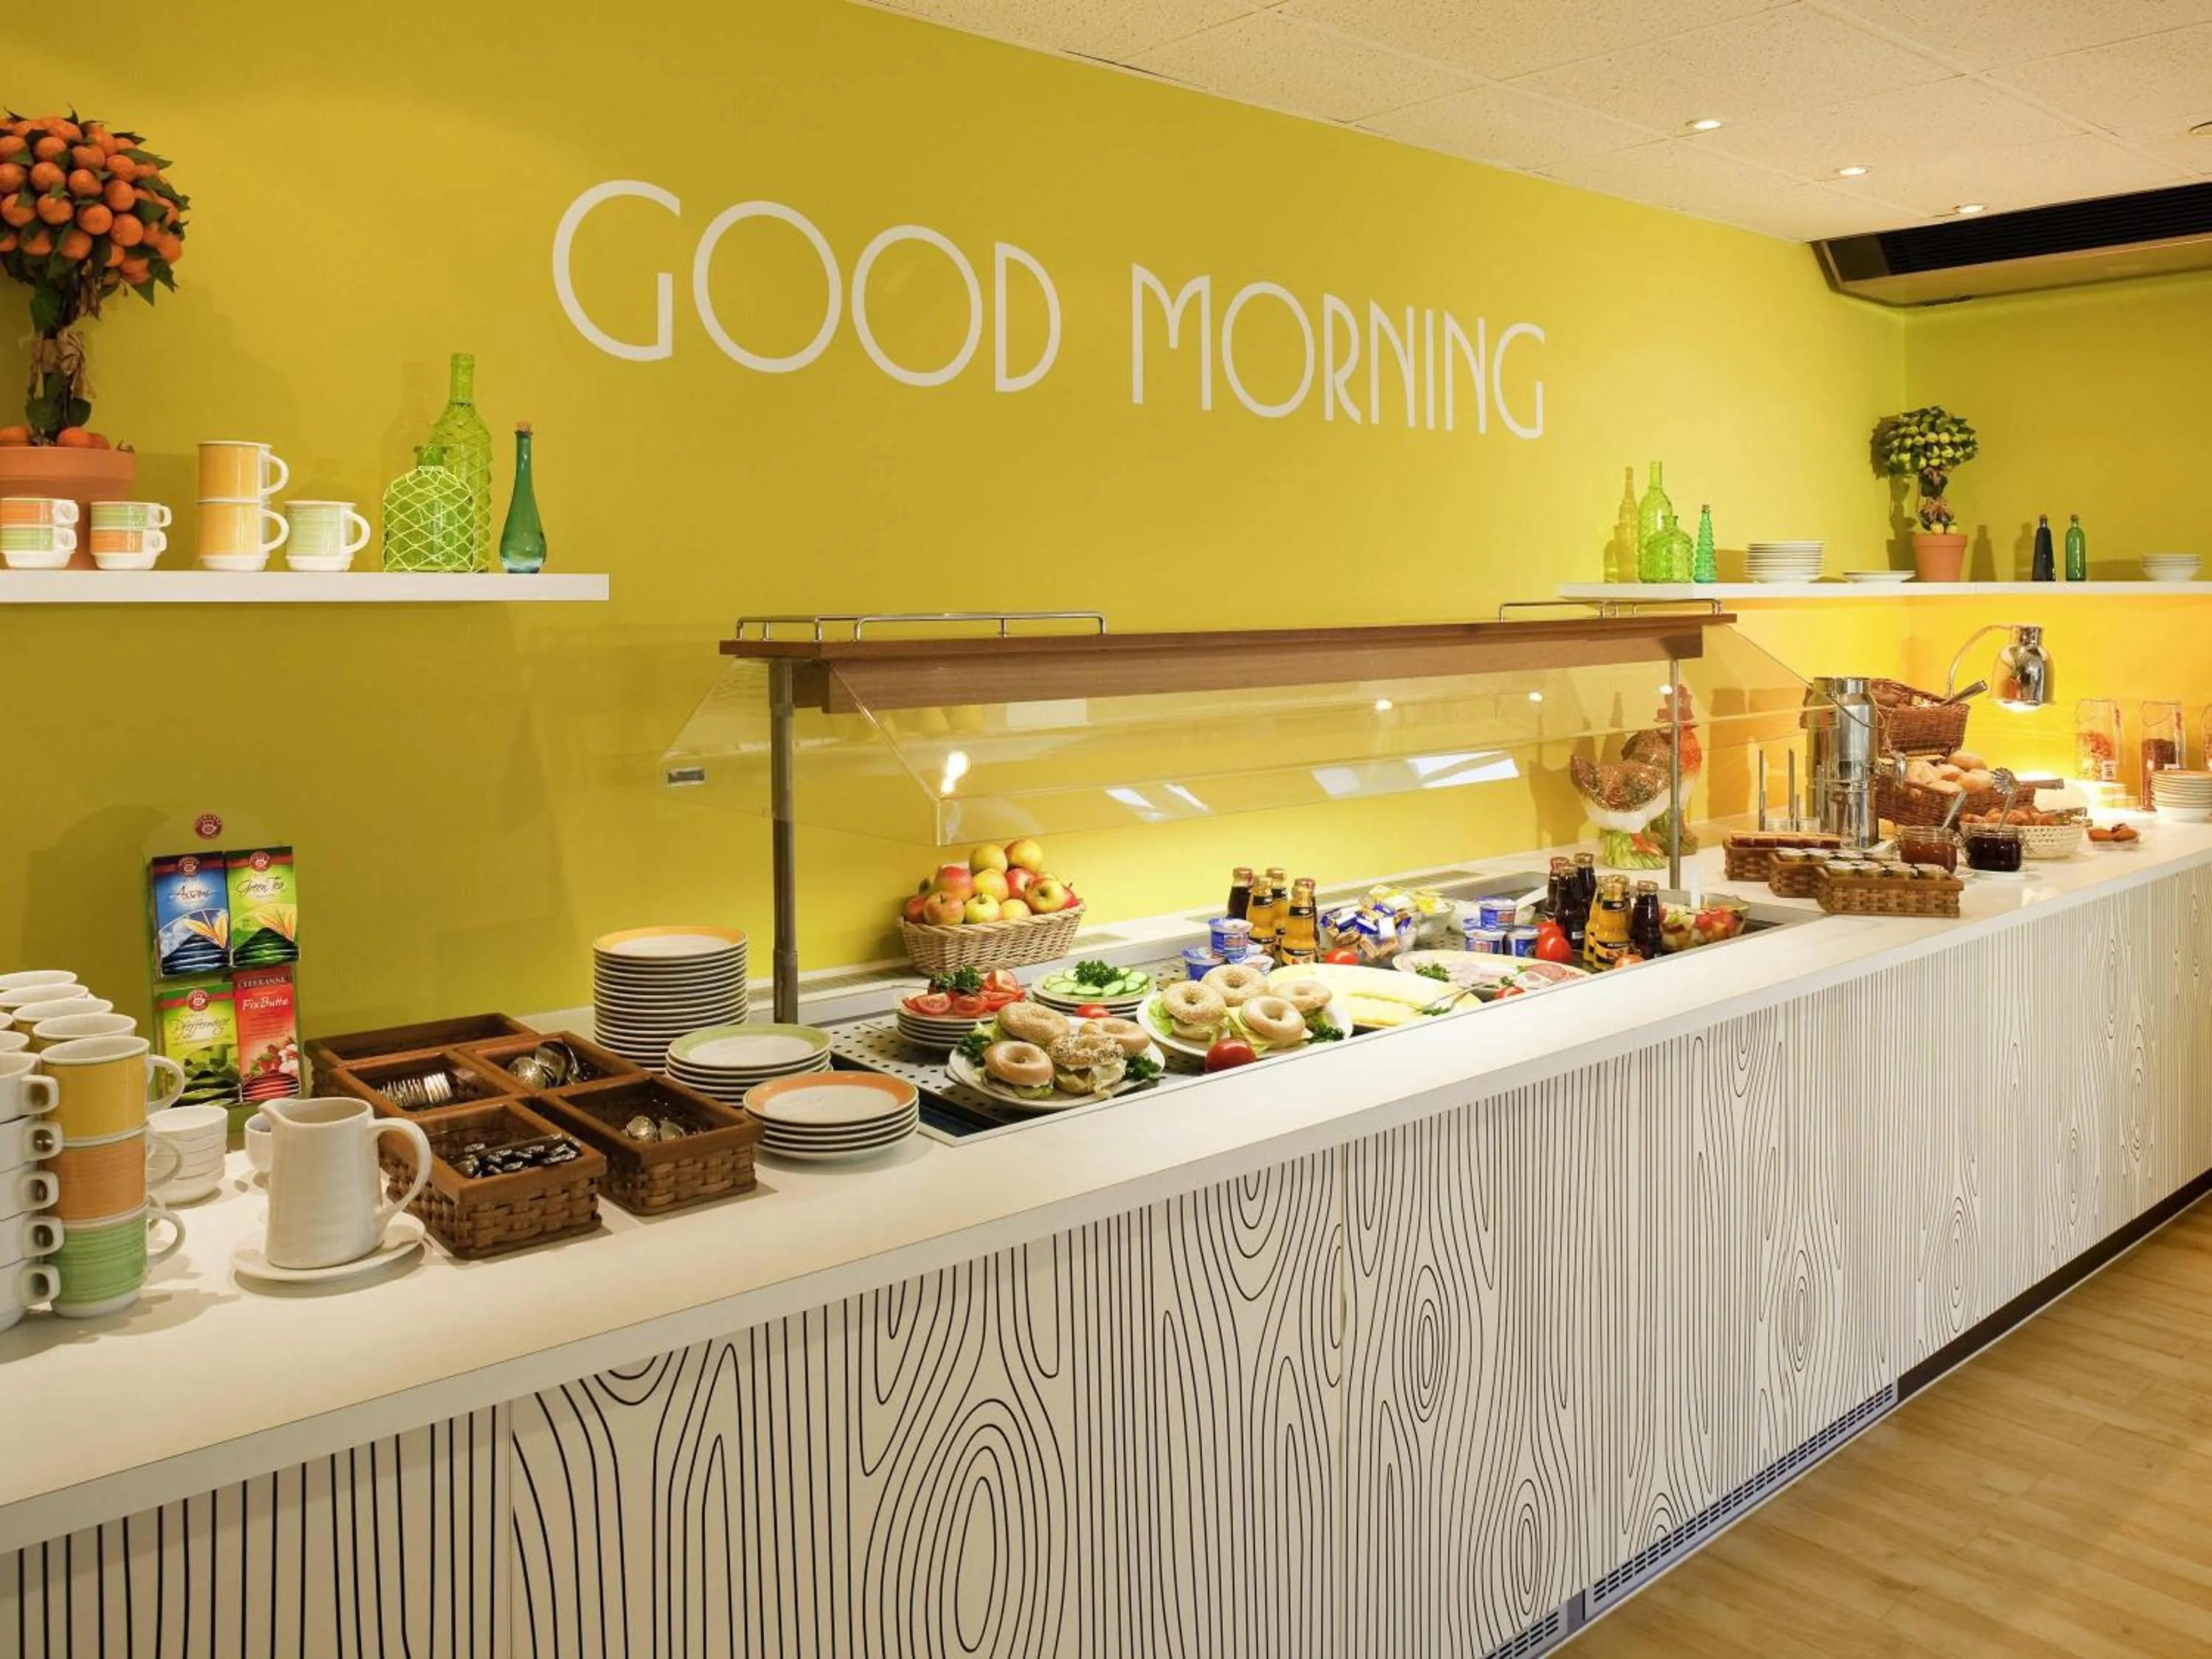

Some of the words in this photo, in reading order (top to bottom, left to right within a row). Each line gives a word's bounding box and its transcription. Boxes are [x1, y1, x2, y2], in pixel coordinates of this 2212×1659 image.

[552, 179, 1062, 392] GOOD
[1131, 263, 1547, 441] MORNING
[243, 977, 287, 988] TEEKANNE
